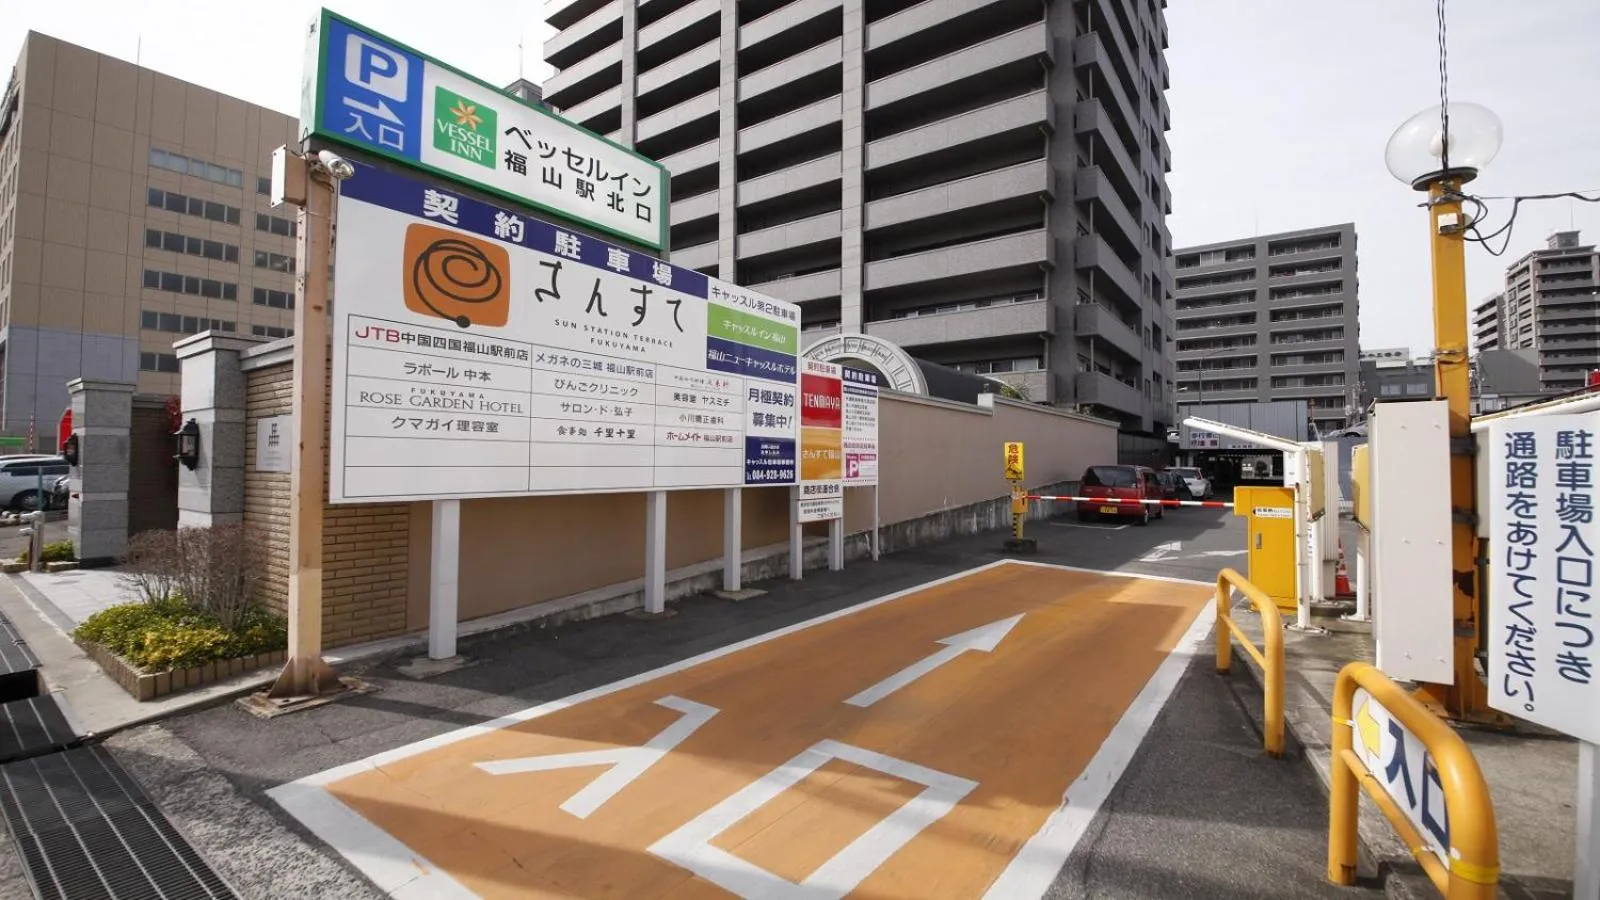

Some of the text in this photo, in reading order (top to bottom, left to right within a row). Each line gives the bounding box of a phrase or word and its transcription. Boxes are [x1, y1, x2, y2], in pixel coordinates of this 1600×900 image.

[360, 43, 399, 88] P
[345, 112, 404, 152] 入口
[437, 118, 494, 154] VESSEL
[450, 140, 482, 161] INN
[504, 125, 652, 198] ベッセルイン
[503, 149, 653, 223] 福山駅北口
[423, 189, 673, 286] 契約駐車場
[534, 260, 684, 333] さんすて
[555, 319, 674, 349] SUN STATION TERRACE
[590, 337, 647, 353] FUKUYAMA
[464, 369, 492, 382] 中本
[536, 351, 654, 379] メガネの三城 福山駅前店
[707, 349, 796, 375] 福山ニューキャッスルホテル
[360, 391, 524, 414] ROSE GARDEN HOTEL
[411, 387, 485, 400] FUKUYAMA
[701, 396, 731, 407] ヤスミチ
[748, 387, 794, 408] 月極契約
[803, 392, 841, 411] TENMAYA
[391, 415, 500, 433] クマガイ理容室
[1503, 430, 1539, 712] 通路をあけてください。
[1554, 428, 1595, 685] 駐車場入口につき
[473, 694, 980, 900] 入口
